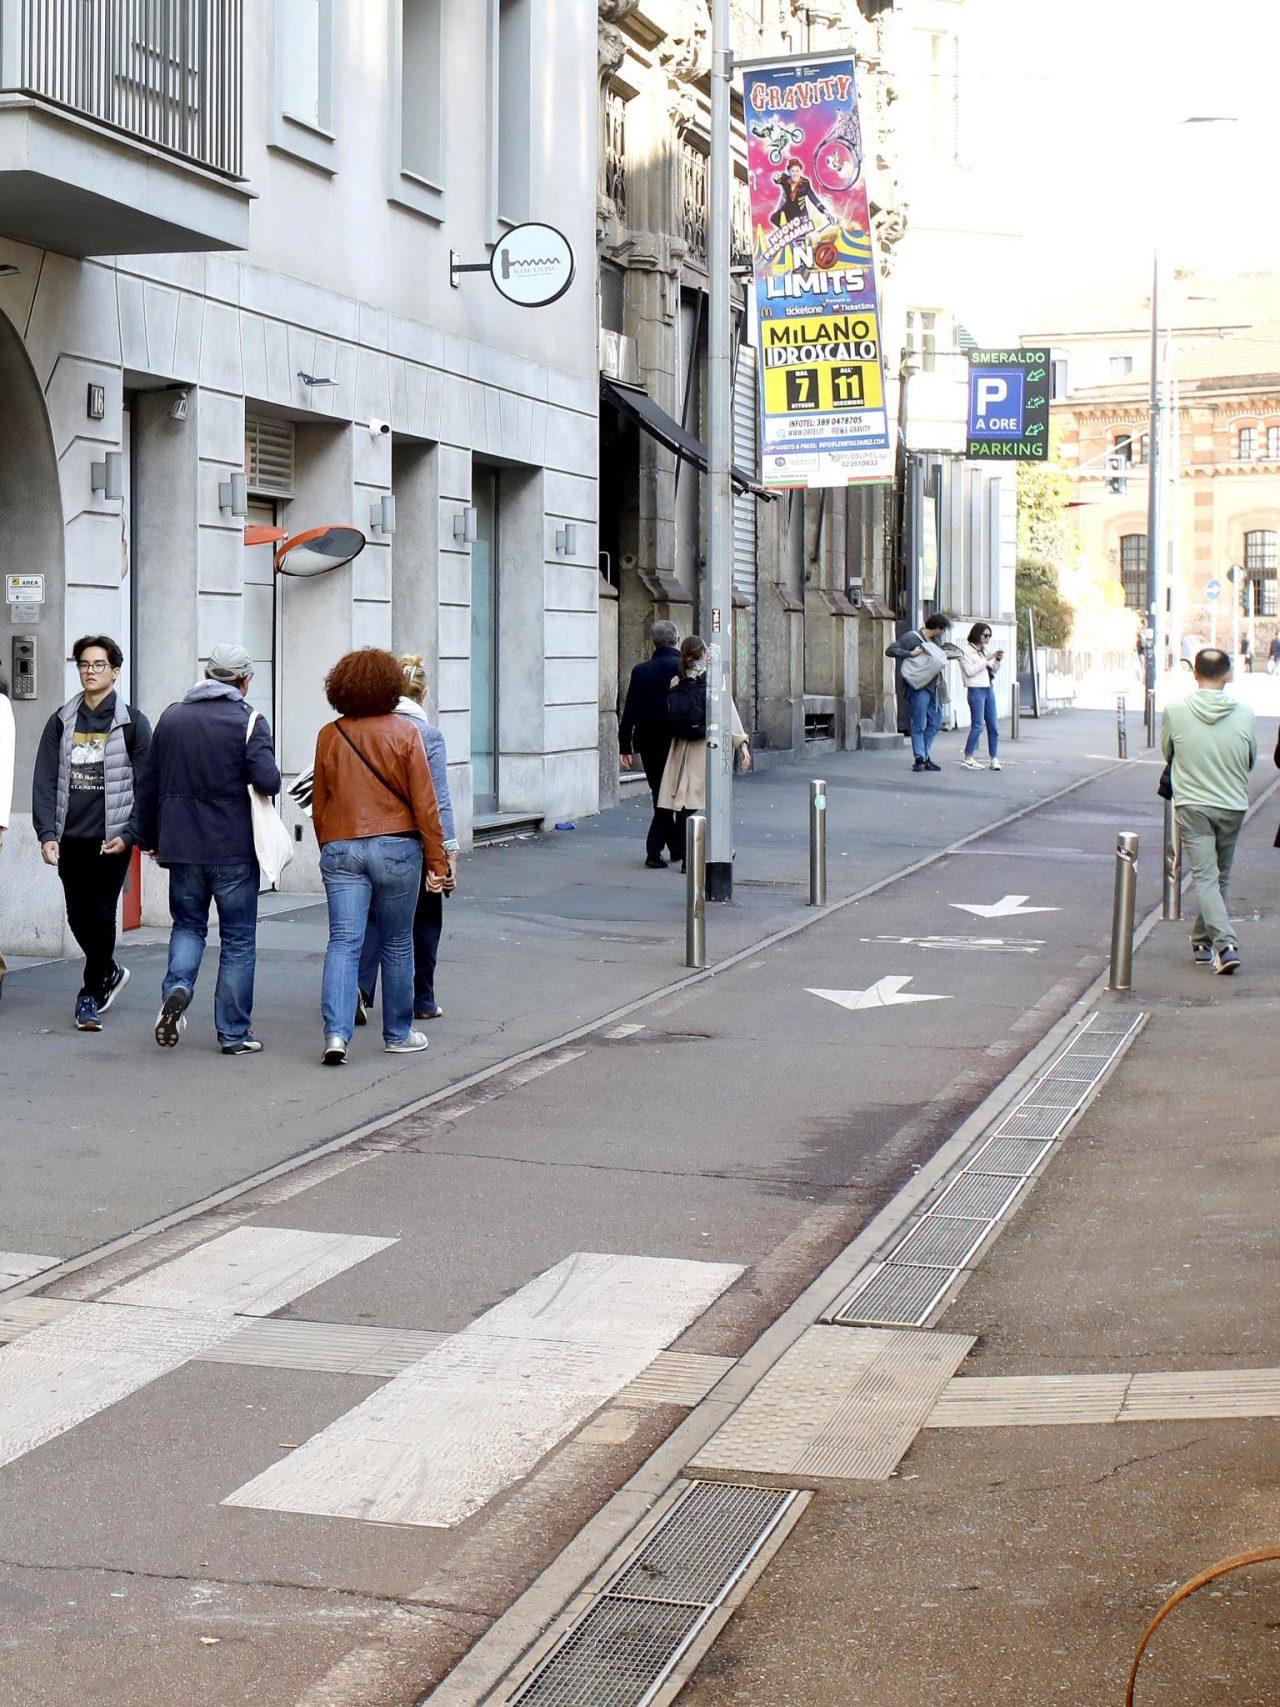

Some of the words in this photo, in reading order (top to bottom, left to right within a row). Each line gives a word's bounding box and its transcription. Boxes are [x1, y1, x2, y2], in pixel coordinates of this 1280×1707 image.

[750, 75, 852, 111] GRAVITY
[763, 220, 815, 261] PROGRAMMA
[769, 216, 801, 244] NUOVO
[766, 269, 865, 300] LIMITS
[786, 305, 824, 316] ticketone
[767, 341, 876, 366] IDROSCALO
[972, 352, 1045, 363] SMERALDO
[796, 378, 809, 402] 7
[835, 375, 860, 400] 11
[977, 378, 1007, 416] P
[94, 388, 104, 414] 16
[789, 419, 815, 428] INFOTEL:
[817, 418, 830, 426] 389
[975, 419, 986, 430] A
[989, 418, 1017, 430] ORE
[970, 442, 1043, 457] PARKING
